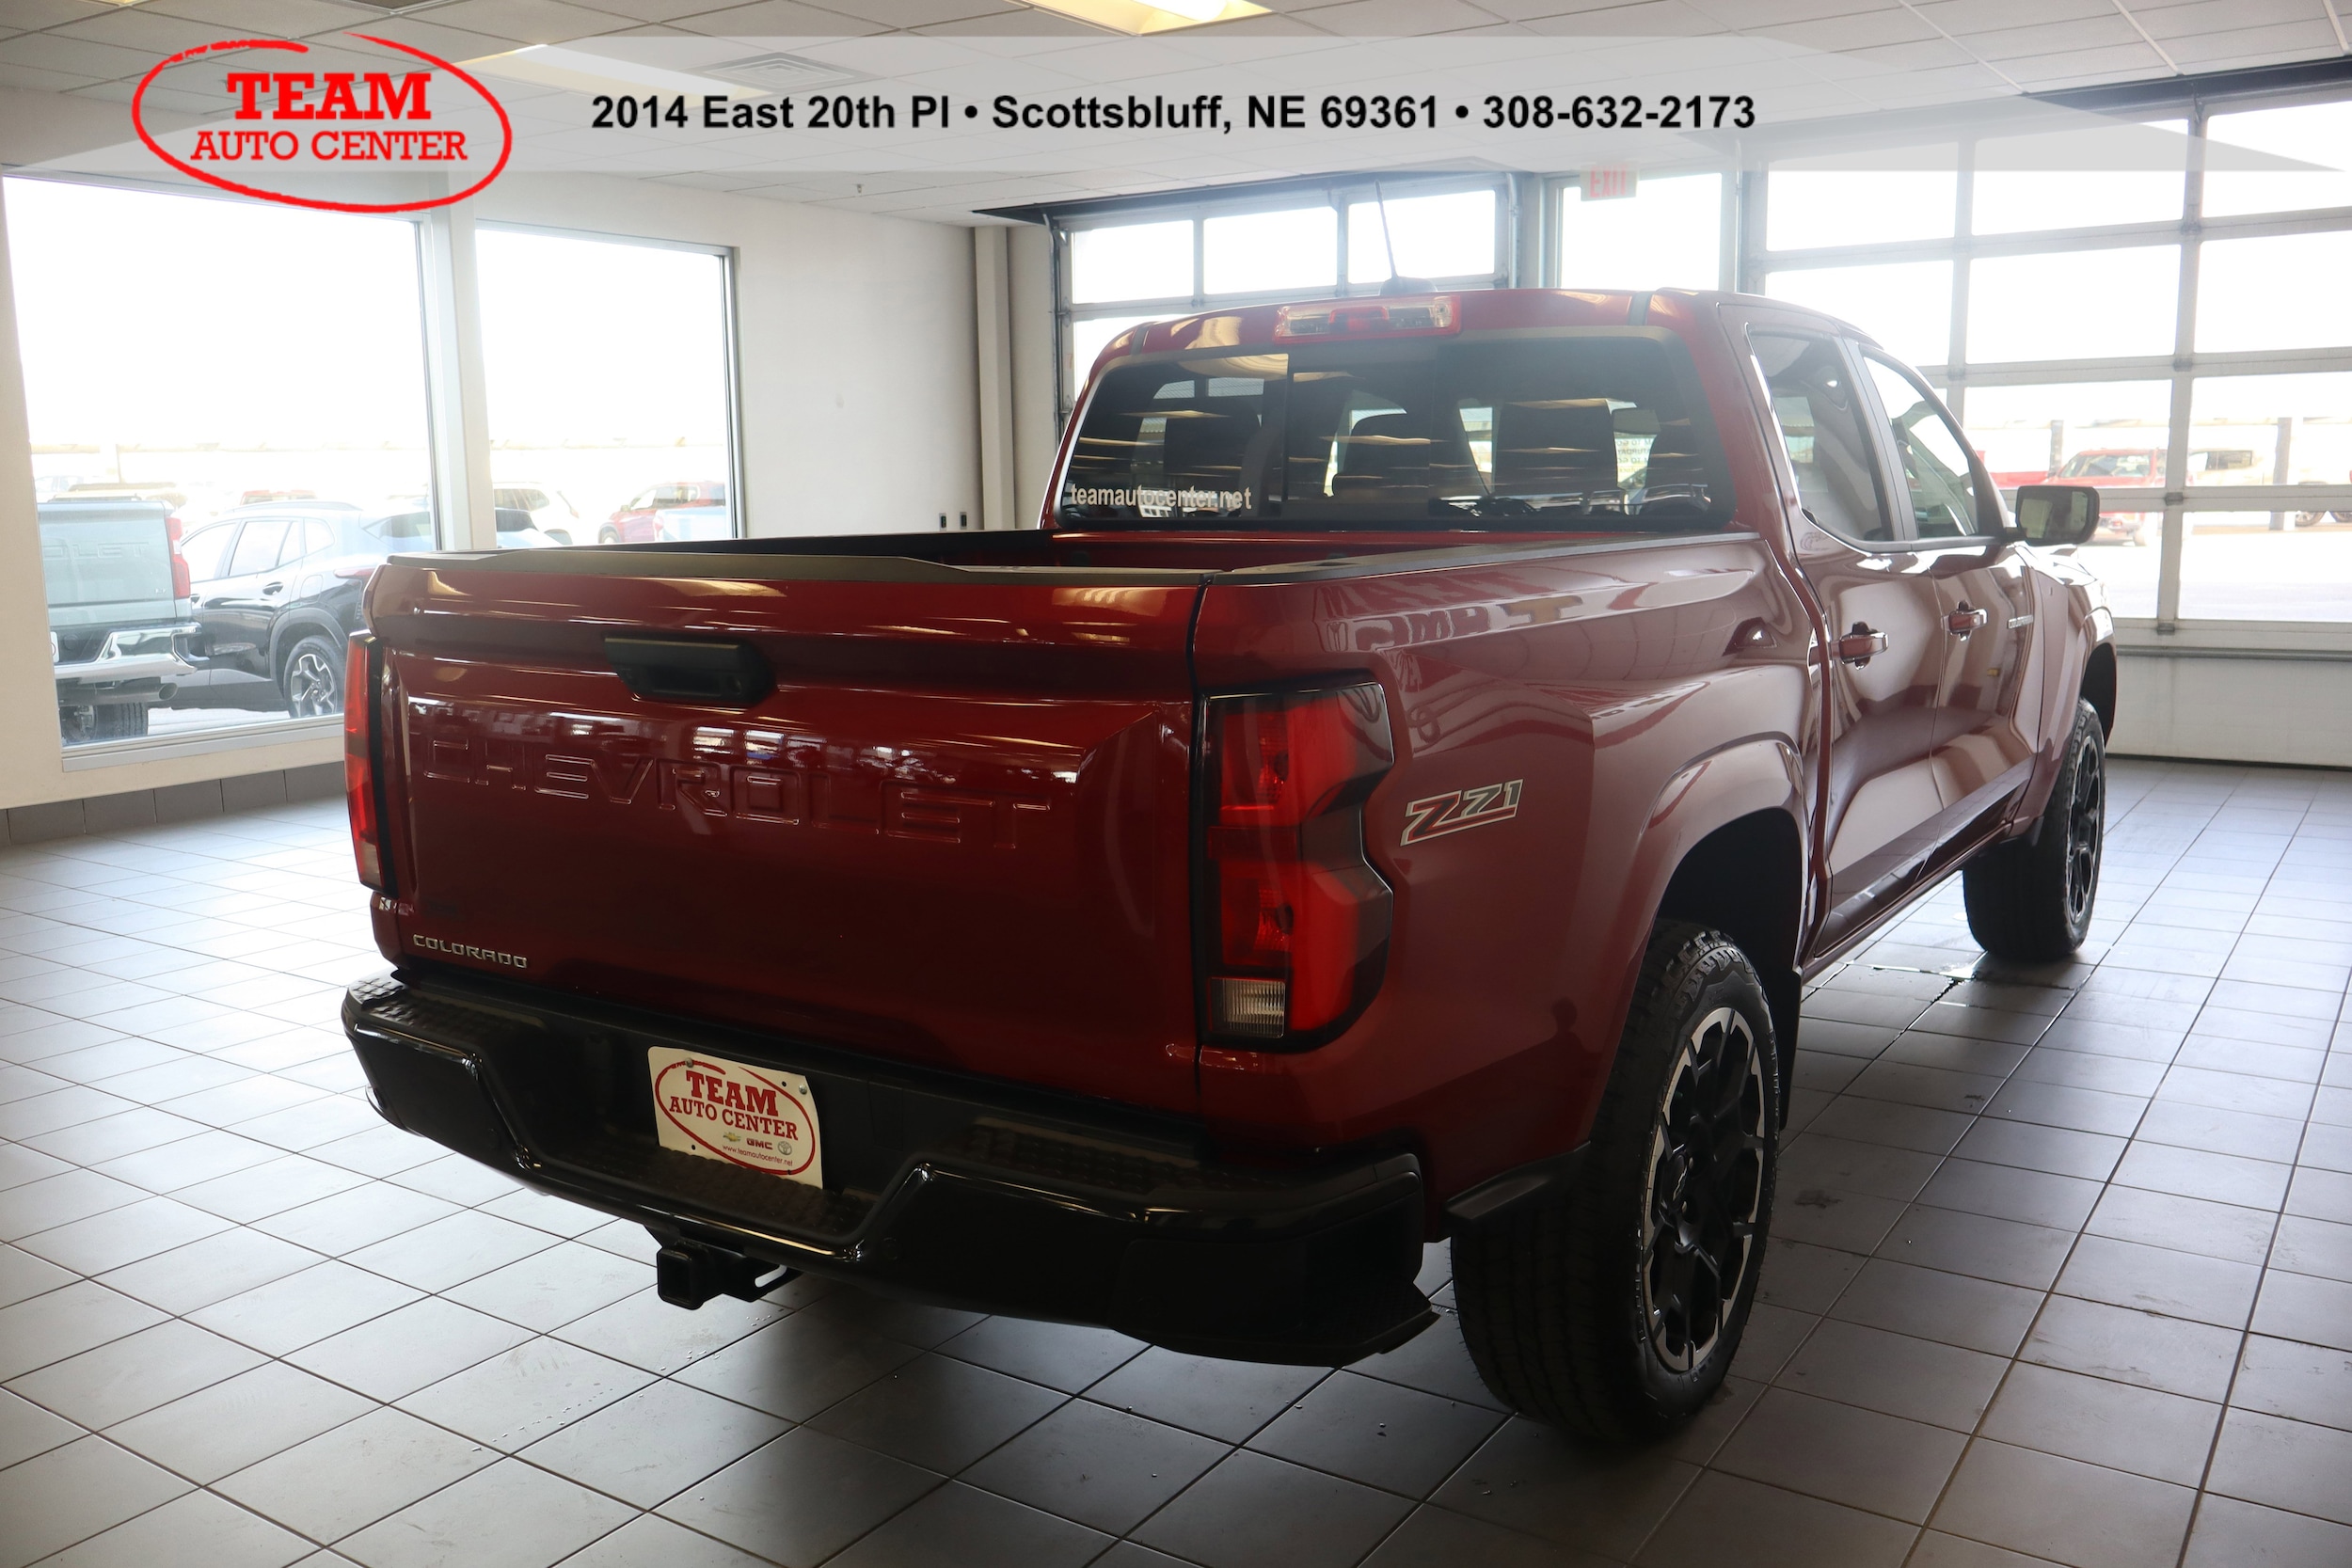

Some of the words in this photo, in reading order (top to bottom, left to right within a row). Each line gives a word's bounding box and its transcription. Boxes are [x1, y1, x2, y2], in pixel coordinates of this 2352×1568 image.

[1589, 165, 1628, 198] EXIT
[1071, 483, 1252, 510] teamautocenter.net
[422, 736, 1052, 848] CHEVROLET
[1400, 779, 1523, 846] Z71
[413, 933, 528, 969] COLORADO
[686, 1069, 779, 1117] TEAM
[669, 1096, 718, 1121] AUTO
[722, 1108, 799, 1141] CENTER
[723, 1145, 793, 1166] www.teamautocenter.net
[746, 1137, 773, 1150] GMC
